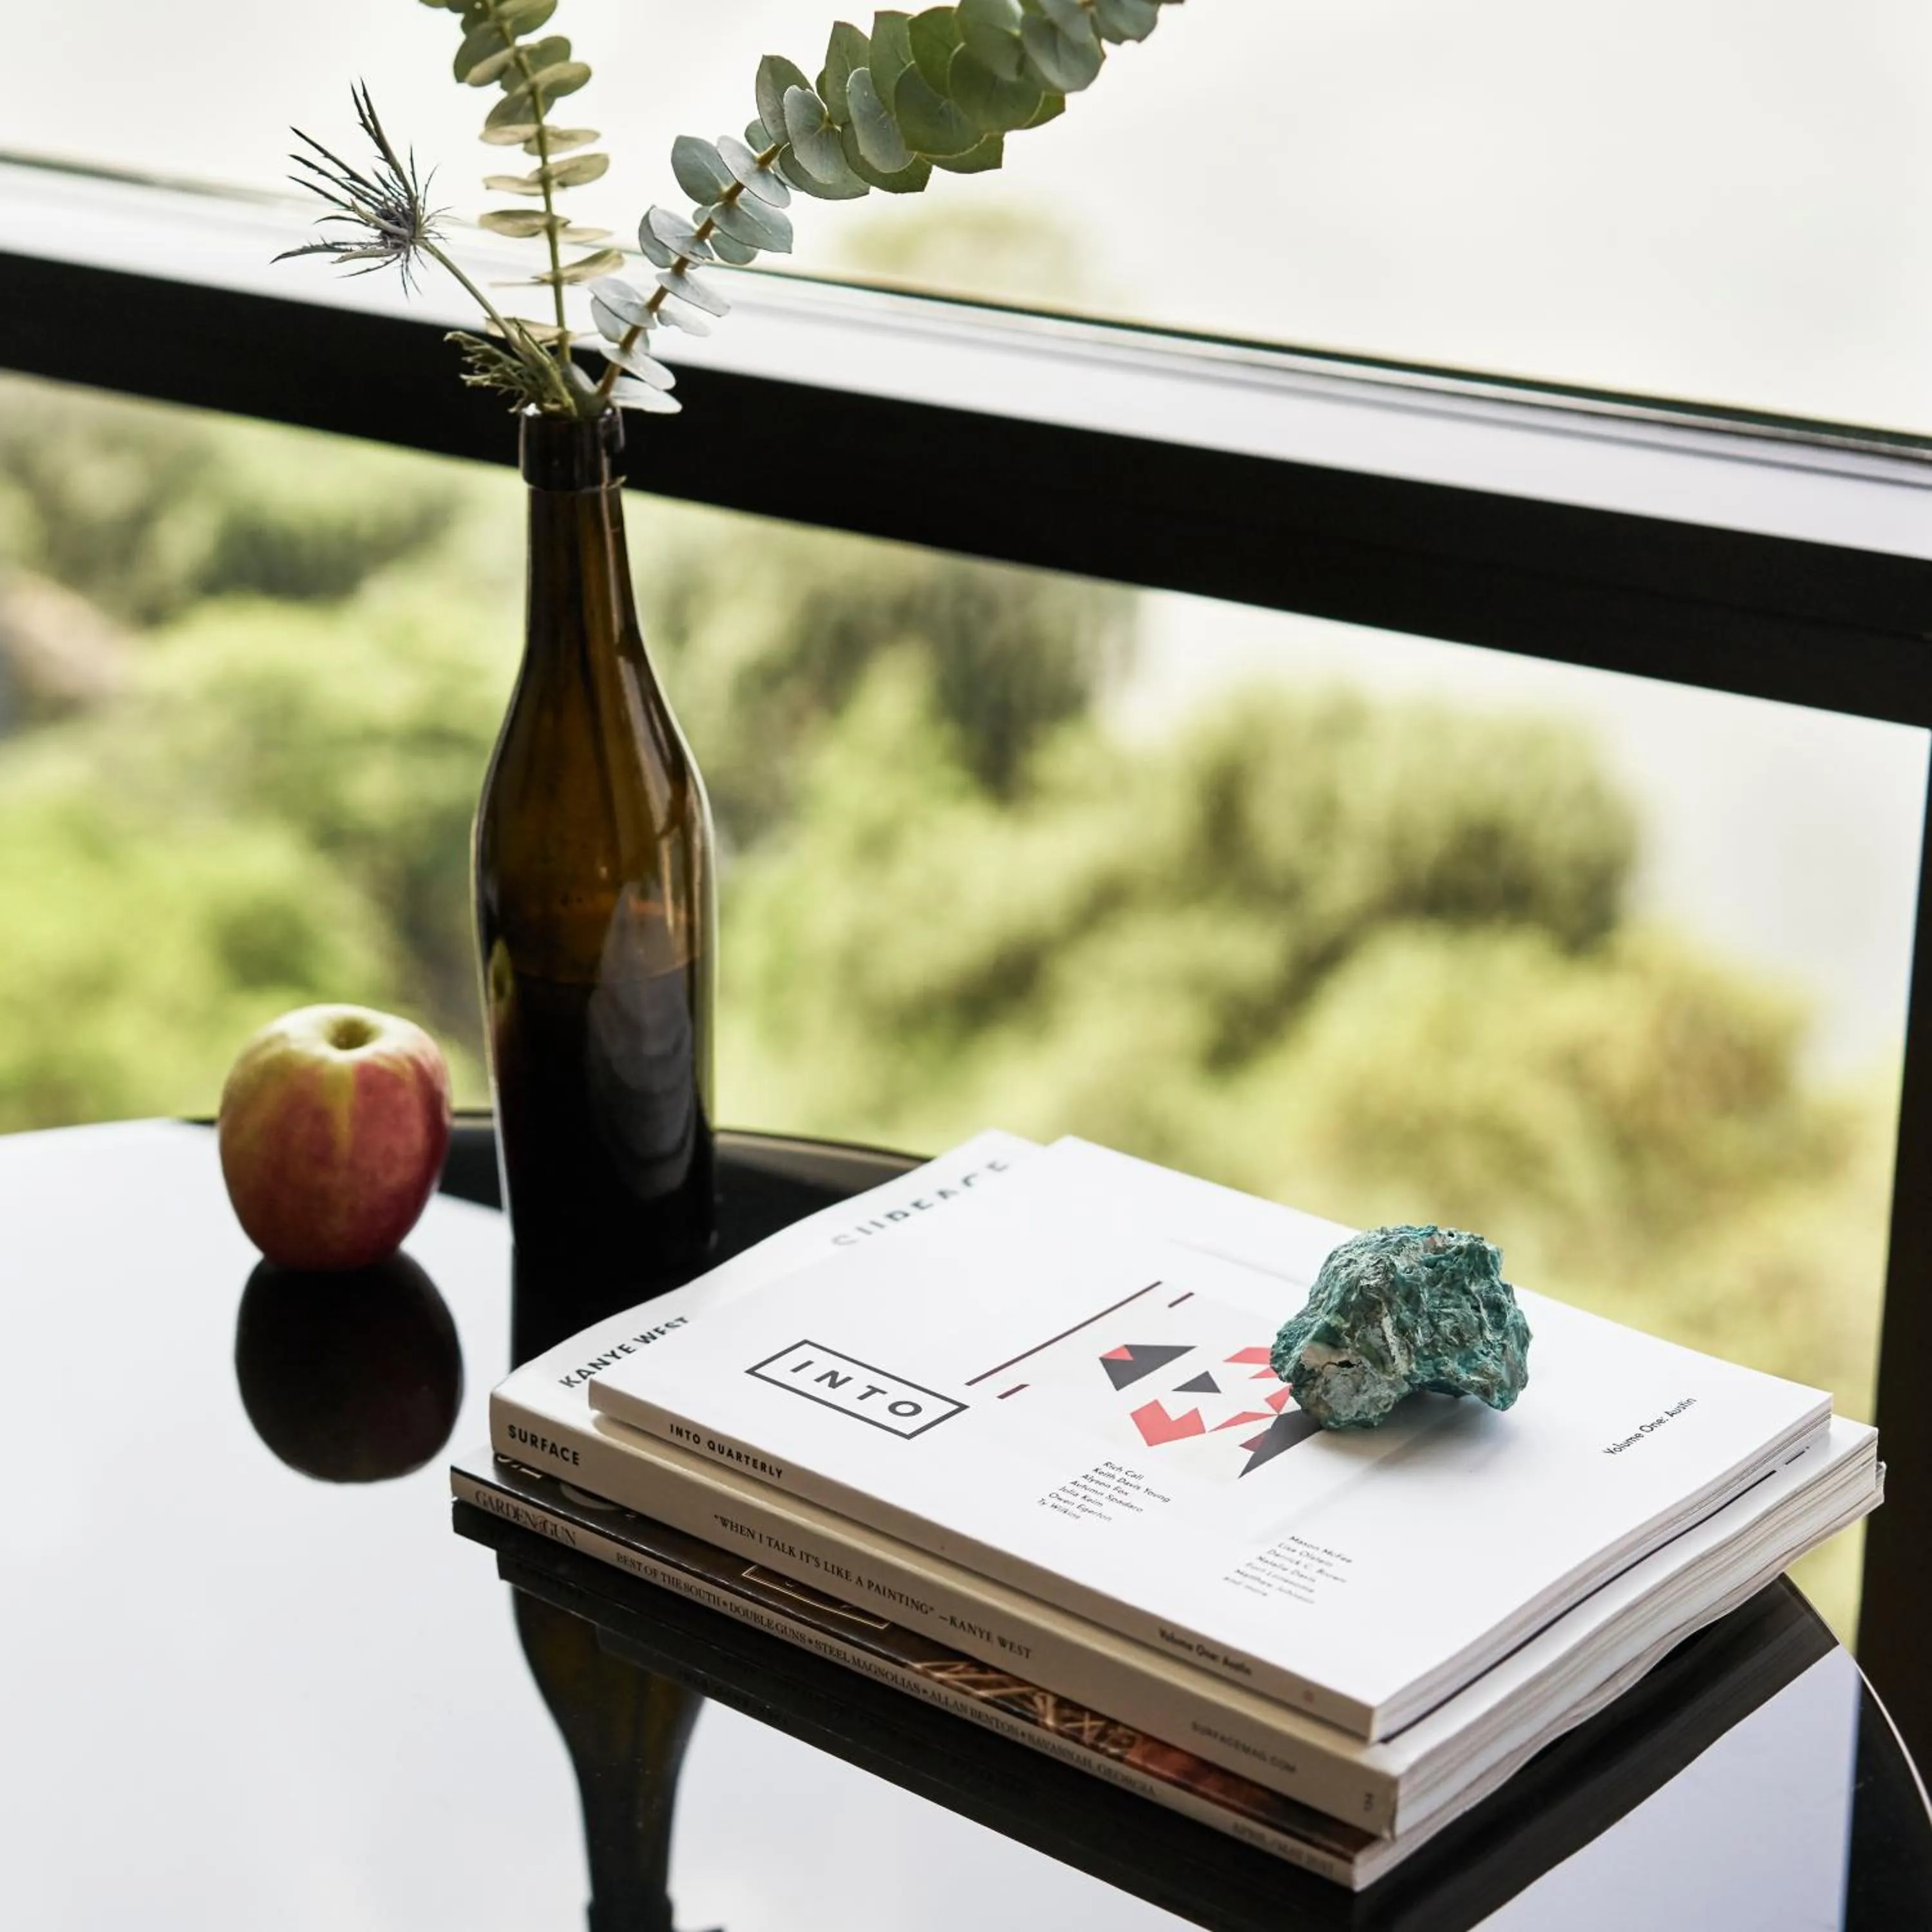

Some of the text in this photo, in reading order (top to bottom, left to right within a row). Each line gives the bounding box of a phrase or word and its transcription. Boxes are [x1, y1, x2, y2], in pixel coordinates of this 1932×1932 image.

[558, 1316, 690, 1388] KANYE WEST
[790, 1360, 922, 1417] INTO
[508, 1424, 580, 1466] SURFACE
[1602, 1433, 1643, 1455] Volume
[1664, 1397, 1697, 1417] Austin
[670, 1423, 784, 1479] INTO QUARTERLY
[1103, 1461, 1144, 1481] Rich Call
[1048, 1492, 1075, 1506] Owen
[1070, 1480, 1104, 1496] Autumn
[1092, 1467, 1171, 1503] Keith Davis Young
[1112, 1485, 1129, 1496] Fox
[714, 1514, 755, 1540] "WHEN
[759, 1533, 763, 1544] I
[766, 1535, 796, 1558] TALK
[799, 1550, 820, 1569] IT'S
[824, 1560, 853, 1582] LIKE
[855, 1575, 864, 1587] A
[867, 1579, 935, 1616] PAINTING"
[996, 1634, 1032, 1660] WEST
[616, 1552, 644, 1573] BEST
[644, 1565, 660, 1577] OF
[660, 1571, 683, 1590] THE
[683, 1582, 721, 1607] SOUTH
[728, 1602, 773, 1631] DOUBLE
[775, 1622, 806, 1643] GUNS
[814, 1639, 854, 1662] STEEL
[852, 1656, 921, 1694] MAGNOLIAS
[929, 1692, 968, 1715] ALLAN
[1159, 1627, 1193, 1651] Volume
[1222, 1656, 1252, 1676] Austin
